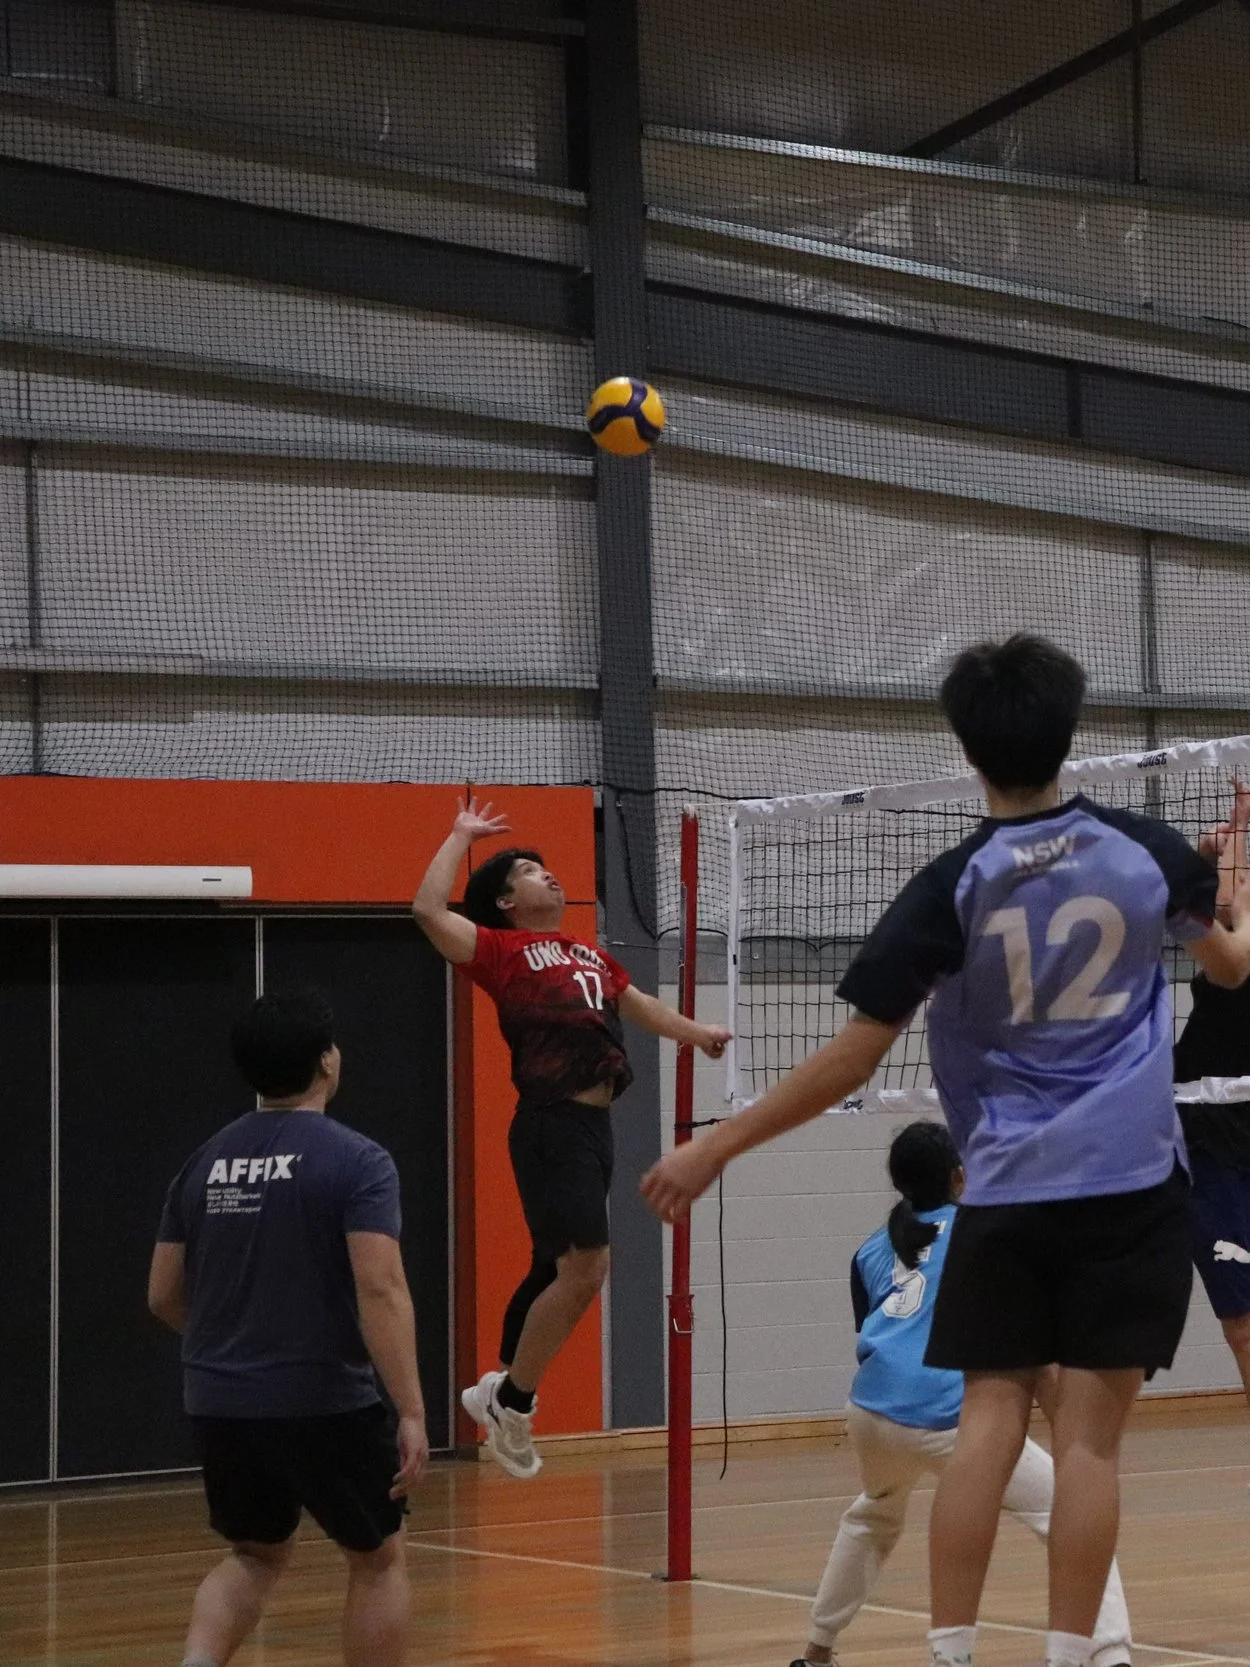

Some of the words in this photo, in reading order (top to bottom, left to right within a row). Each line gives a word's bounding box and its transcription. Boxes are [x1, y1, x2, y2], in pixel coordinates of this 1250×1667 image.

[981, 896, 1132, 1025] 12
[573, 970, 604, 1010] 17
[206, 1154, 296, 1185] AFFIX
